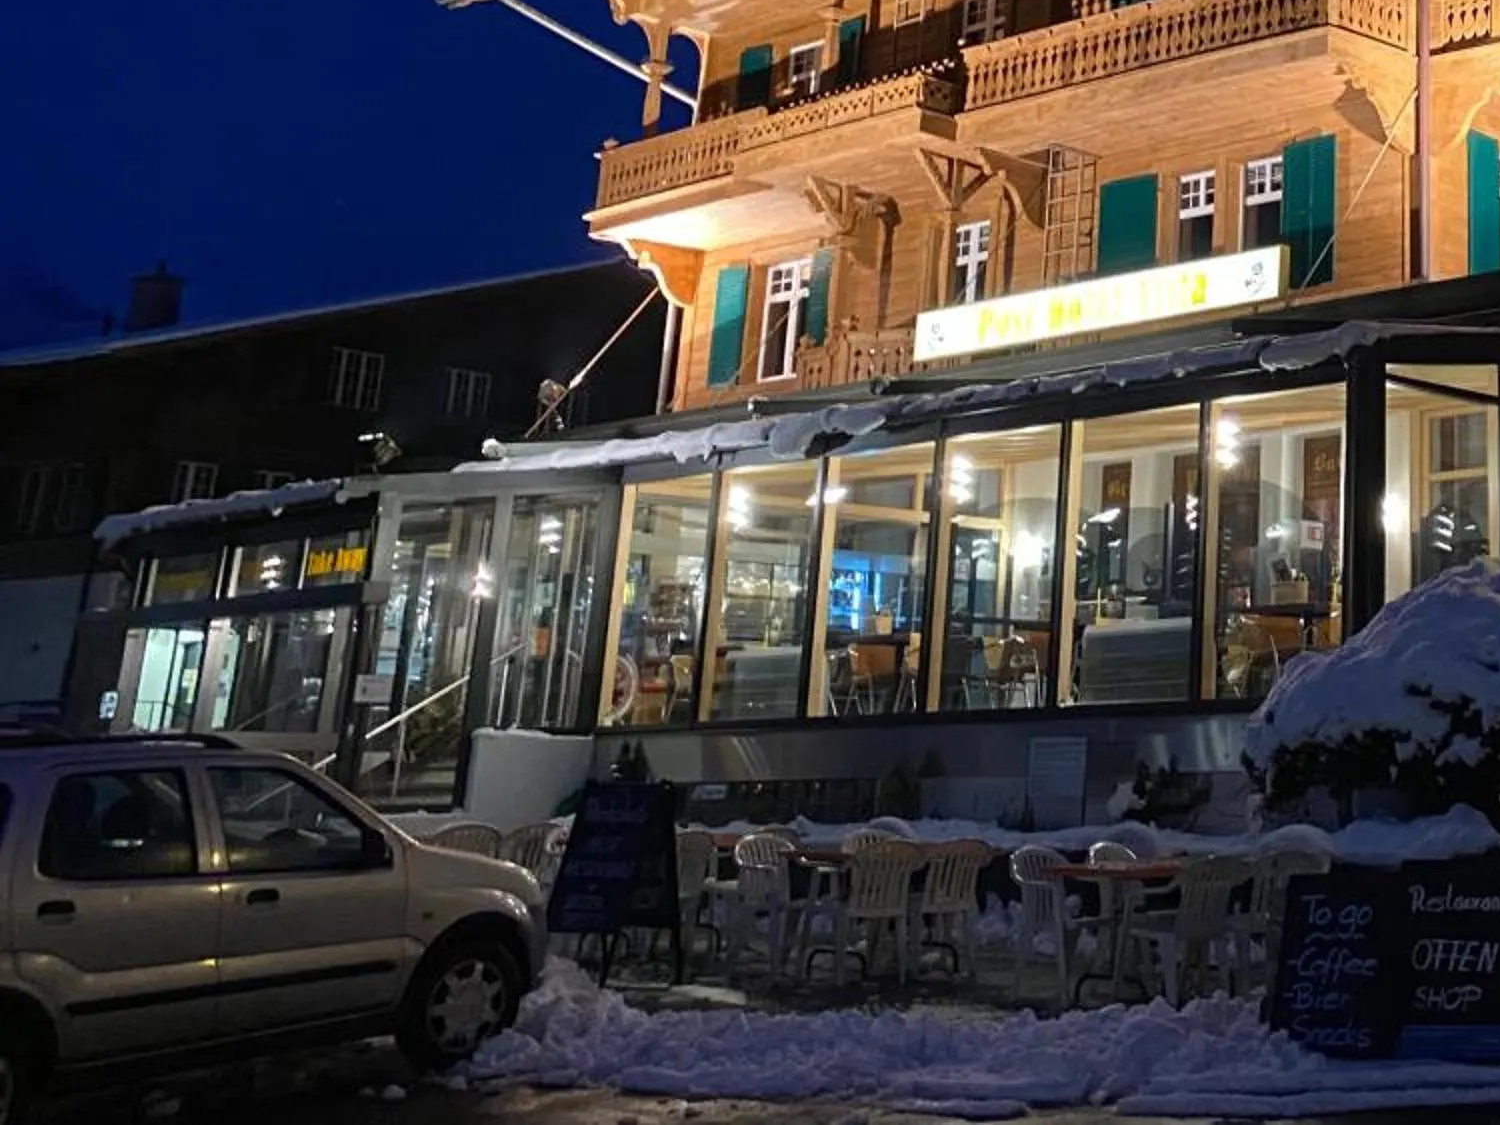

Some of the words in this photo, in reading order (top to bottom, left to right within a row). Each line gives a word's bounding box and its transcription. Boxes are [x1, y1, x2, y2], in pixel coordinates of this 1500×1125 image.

[1300, 894, 1331, 925] To
[1338, 904, 1373, 934] go
[1411, 938, 1500, 974] OFFEN
[1413, 983, 1483, 1012] SHOP
